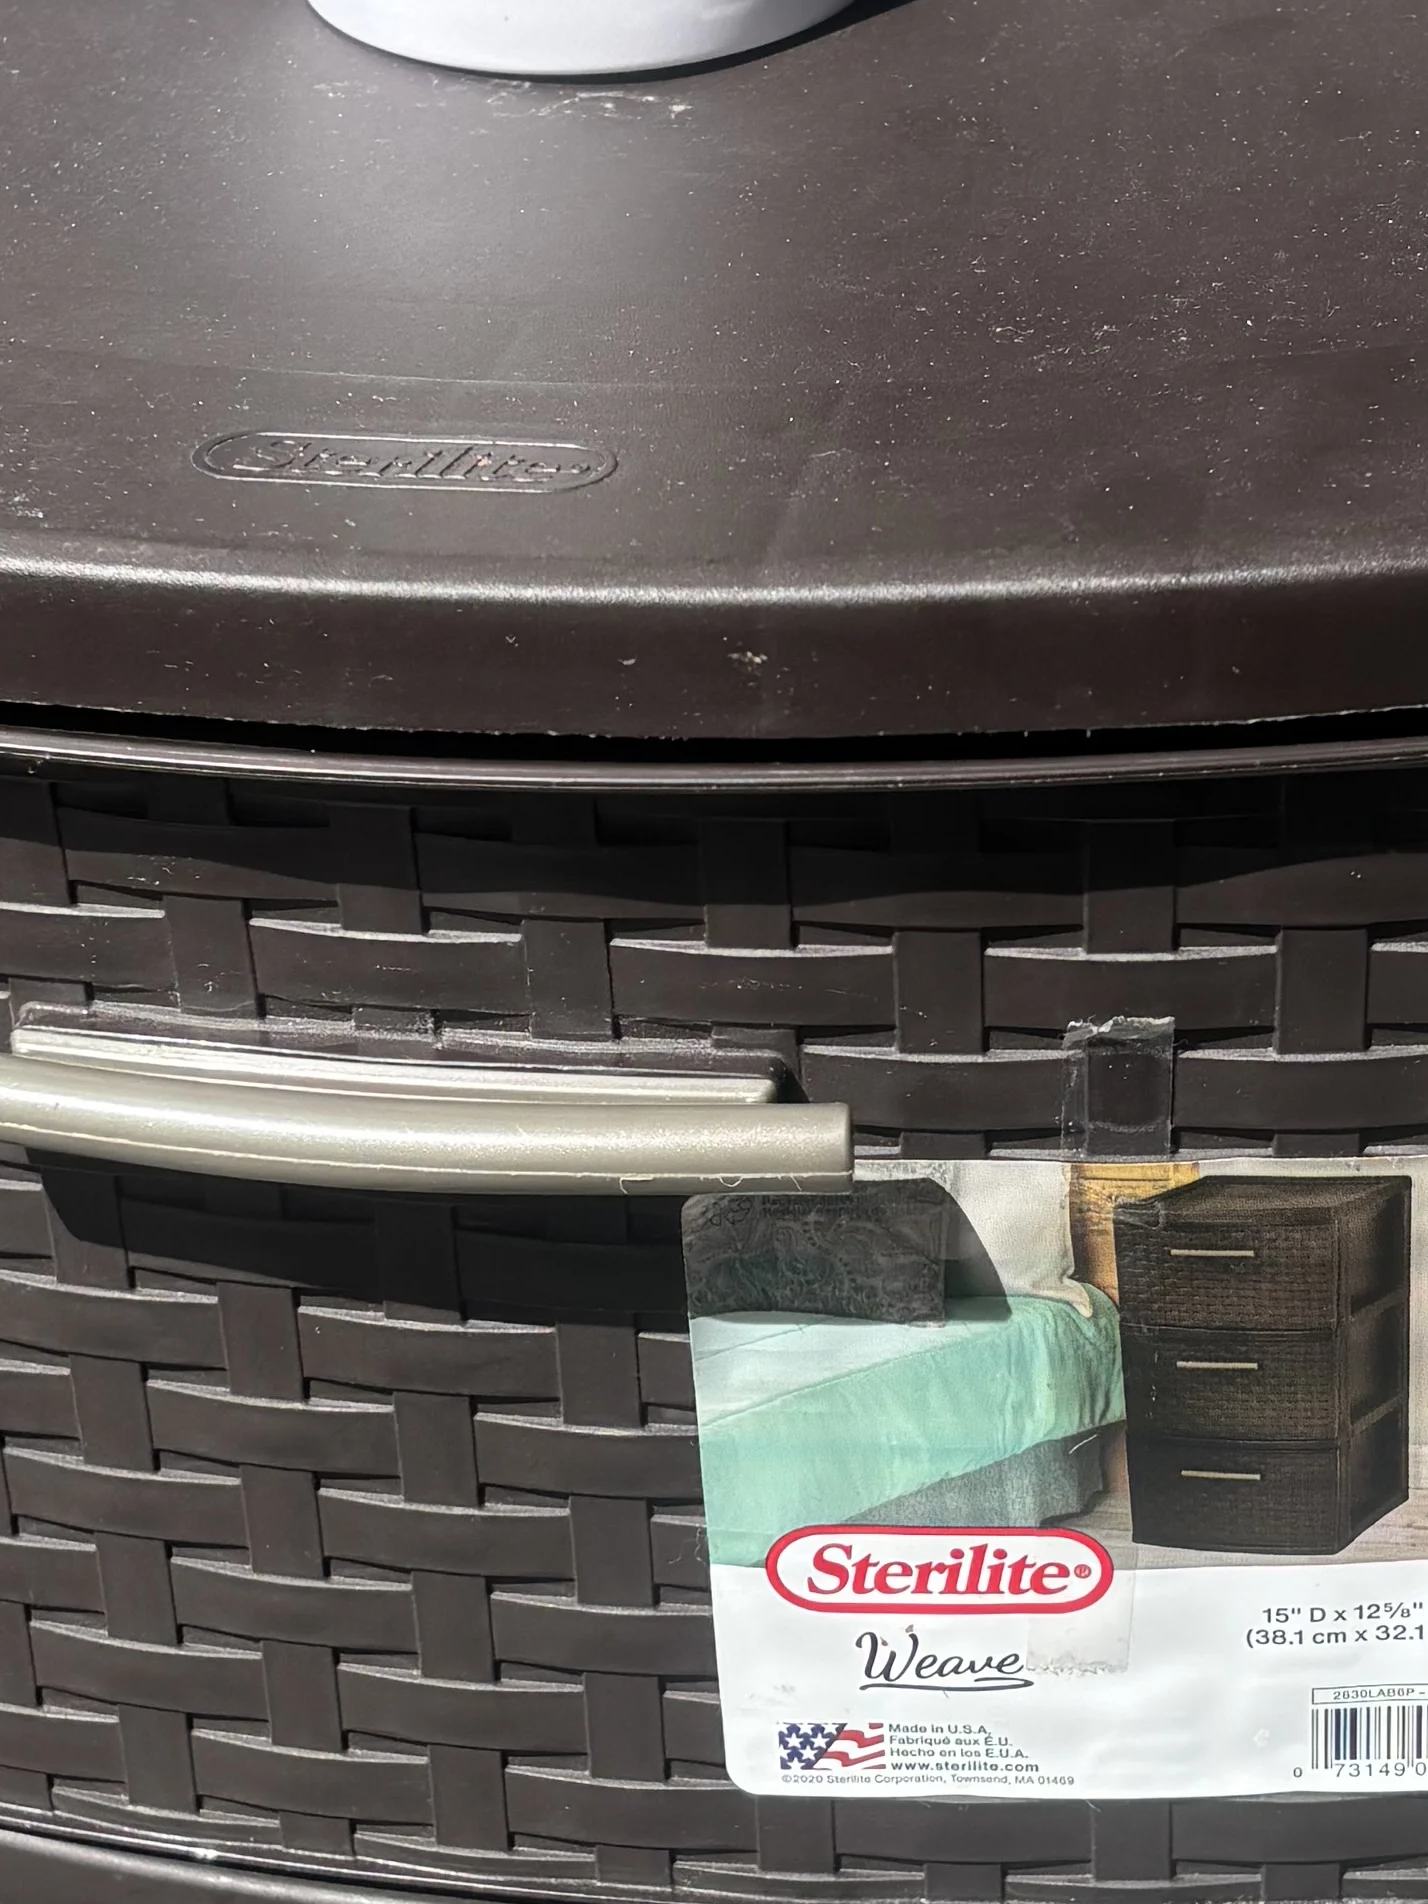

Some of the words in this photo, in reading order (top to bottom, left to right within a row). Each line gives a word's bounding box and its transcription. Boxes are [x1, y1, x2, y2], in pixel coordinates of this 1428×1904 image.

[1262, 1608, 1301, 1624] 15"
[1310, 1607, 1326, 1623] D
[1334, 1609, 1348, 1622] x
[1246, 1628, 1303, 1648] (38.1
[1312, 1631, 1347, 1645] cm
[1355, 1629, 1368, 1642] x
[1375, 1624, 1424, 1641] 32.1
[855, 1632, 1025, 1682] Weave
[888, 1723, 927, 1733] Made
[931, 1724, 944, 1734] in
[955, 1738, 980, 1746] aux
[890, 1747, 935, 1757] Hecho
[939, 1749, 957, 1757] en
[960, 1748, 981, 1758] los
[890, 1761, 1040, 1772] www.sterilite.com
[1292, 1766, 1303, 1778] 0
[1334, 1762, 1406, 1778] 73149
[827, 1775, 871, 1784] Sterilite
